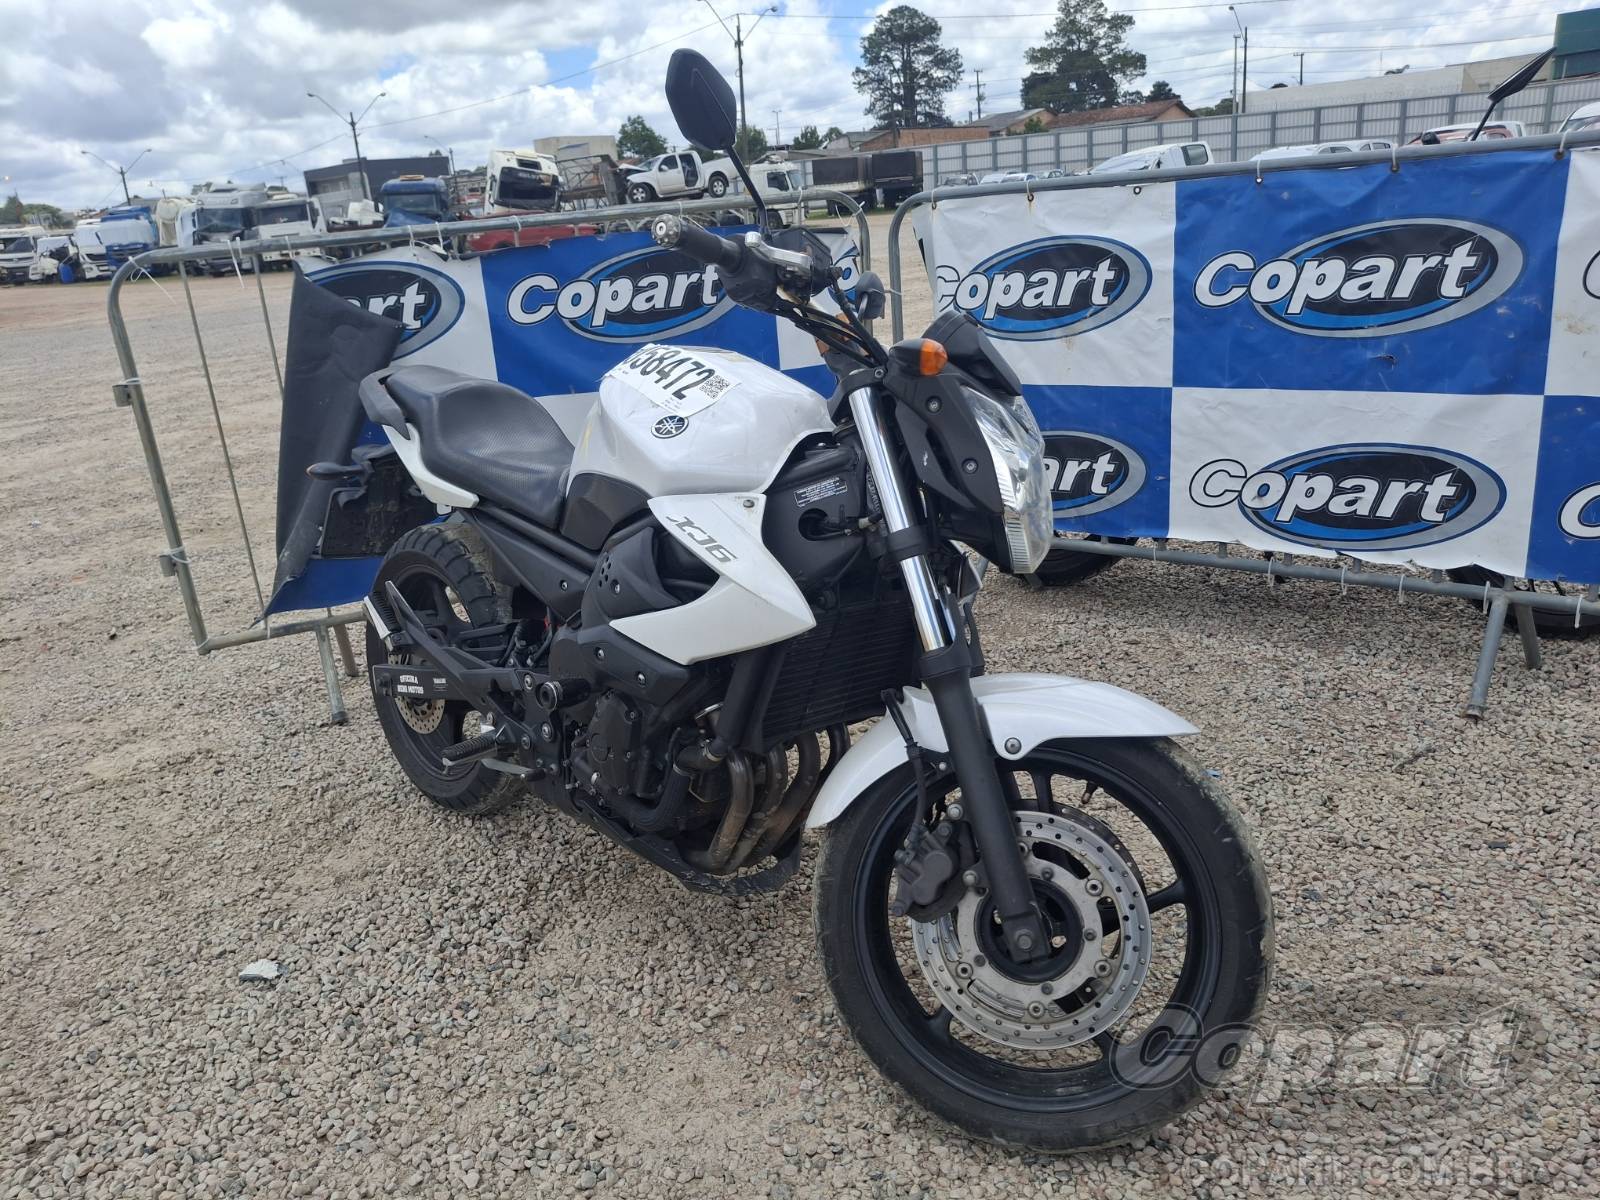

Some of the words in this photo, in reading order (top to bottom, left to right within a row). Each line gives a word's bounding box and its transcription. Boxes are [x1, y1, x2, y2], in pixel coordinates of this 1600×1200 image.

[507, 264, 720, 328] Copart
[1195, 241, 1479, 316] Copart
[1189, 459, 1458, 523] Copart
